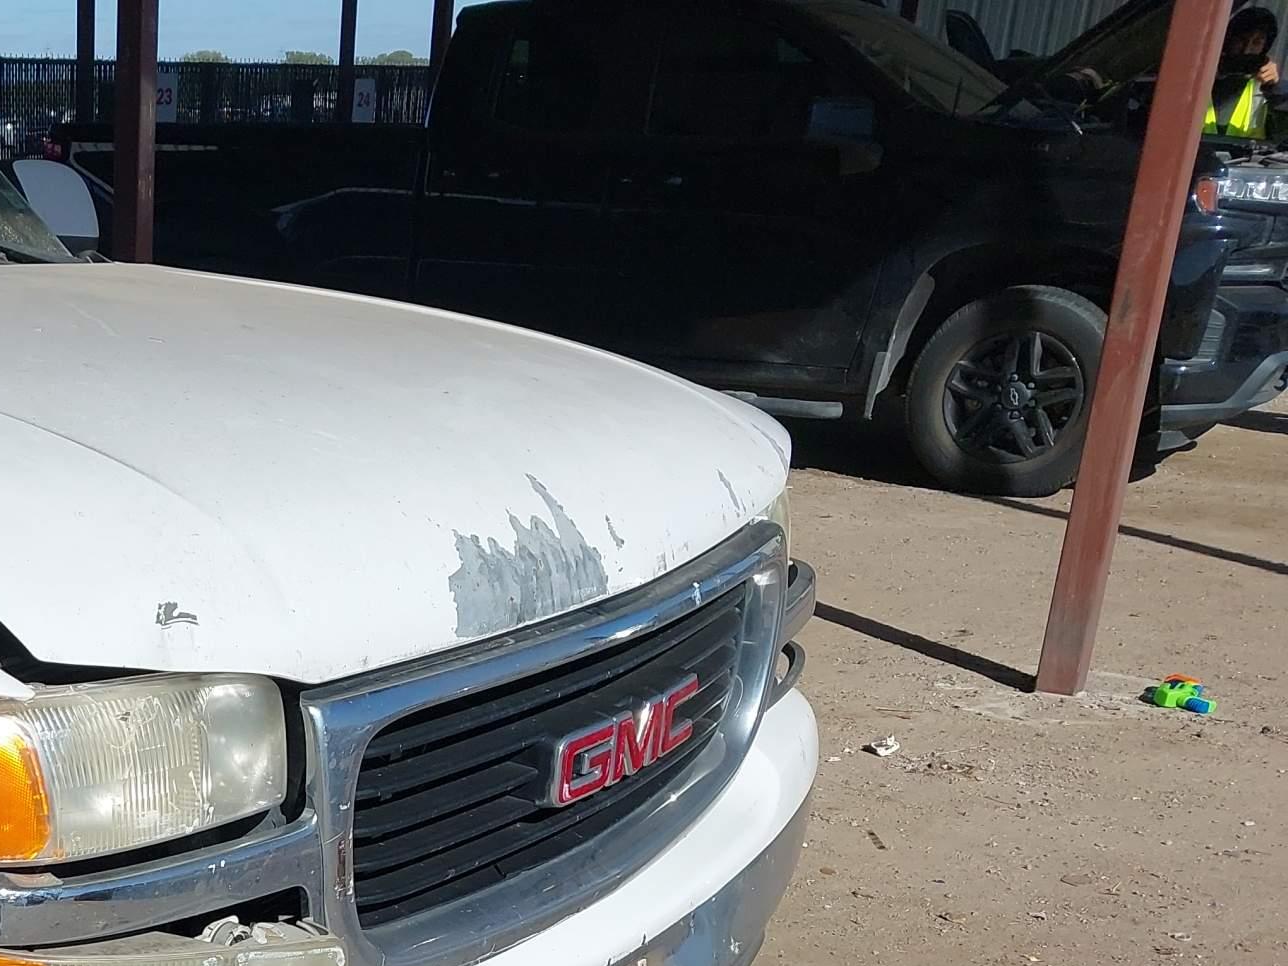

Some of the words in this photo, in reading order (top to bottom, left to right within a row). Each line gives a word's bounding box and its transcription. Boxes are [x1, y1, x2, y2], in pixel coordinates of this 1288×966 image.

[156, 87, 173, 105] 23
[357, 91, 370, 108] 24
[553, 673, 699, 807] GMC
